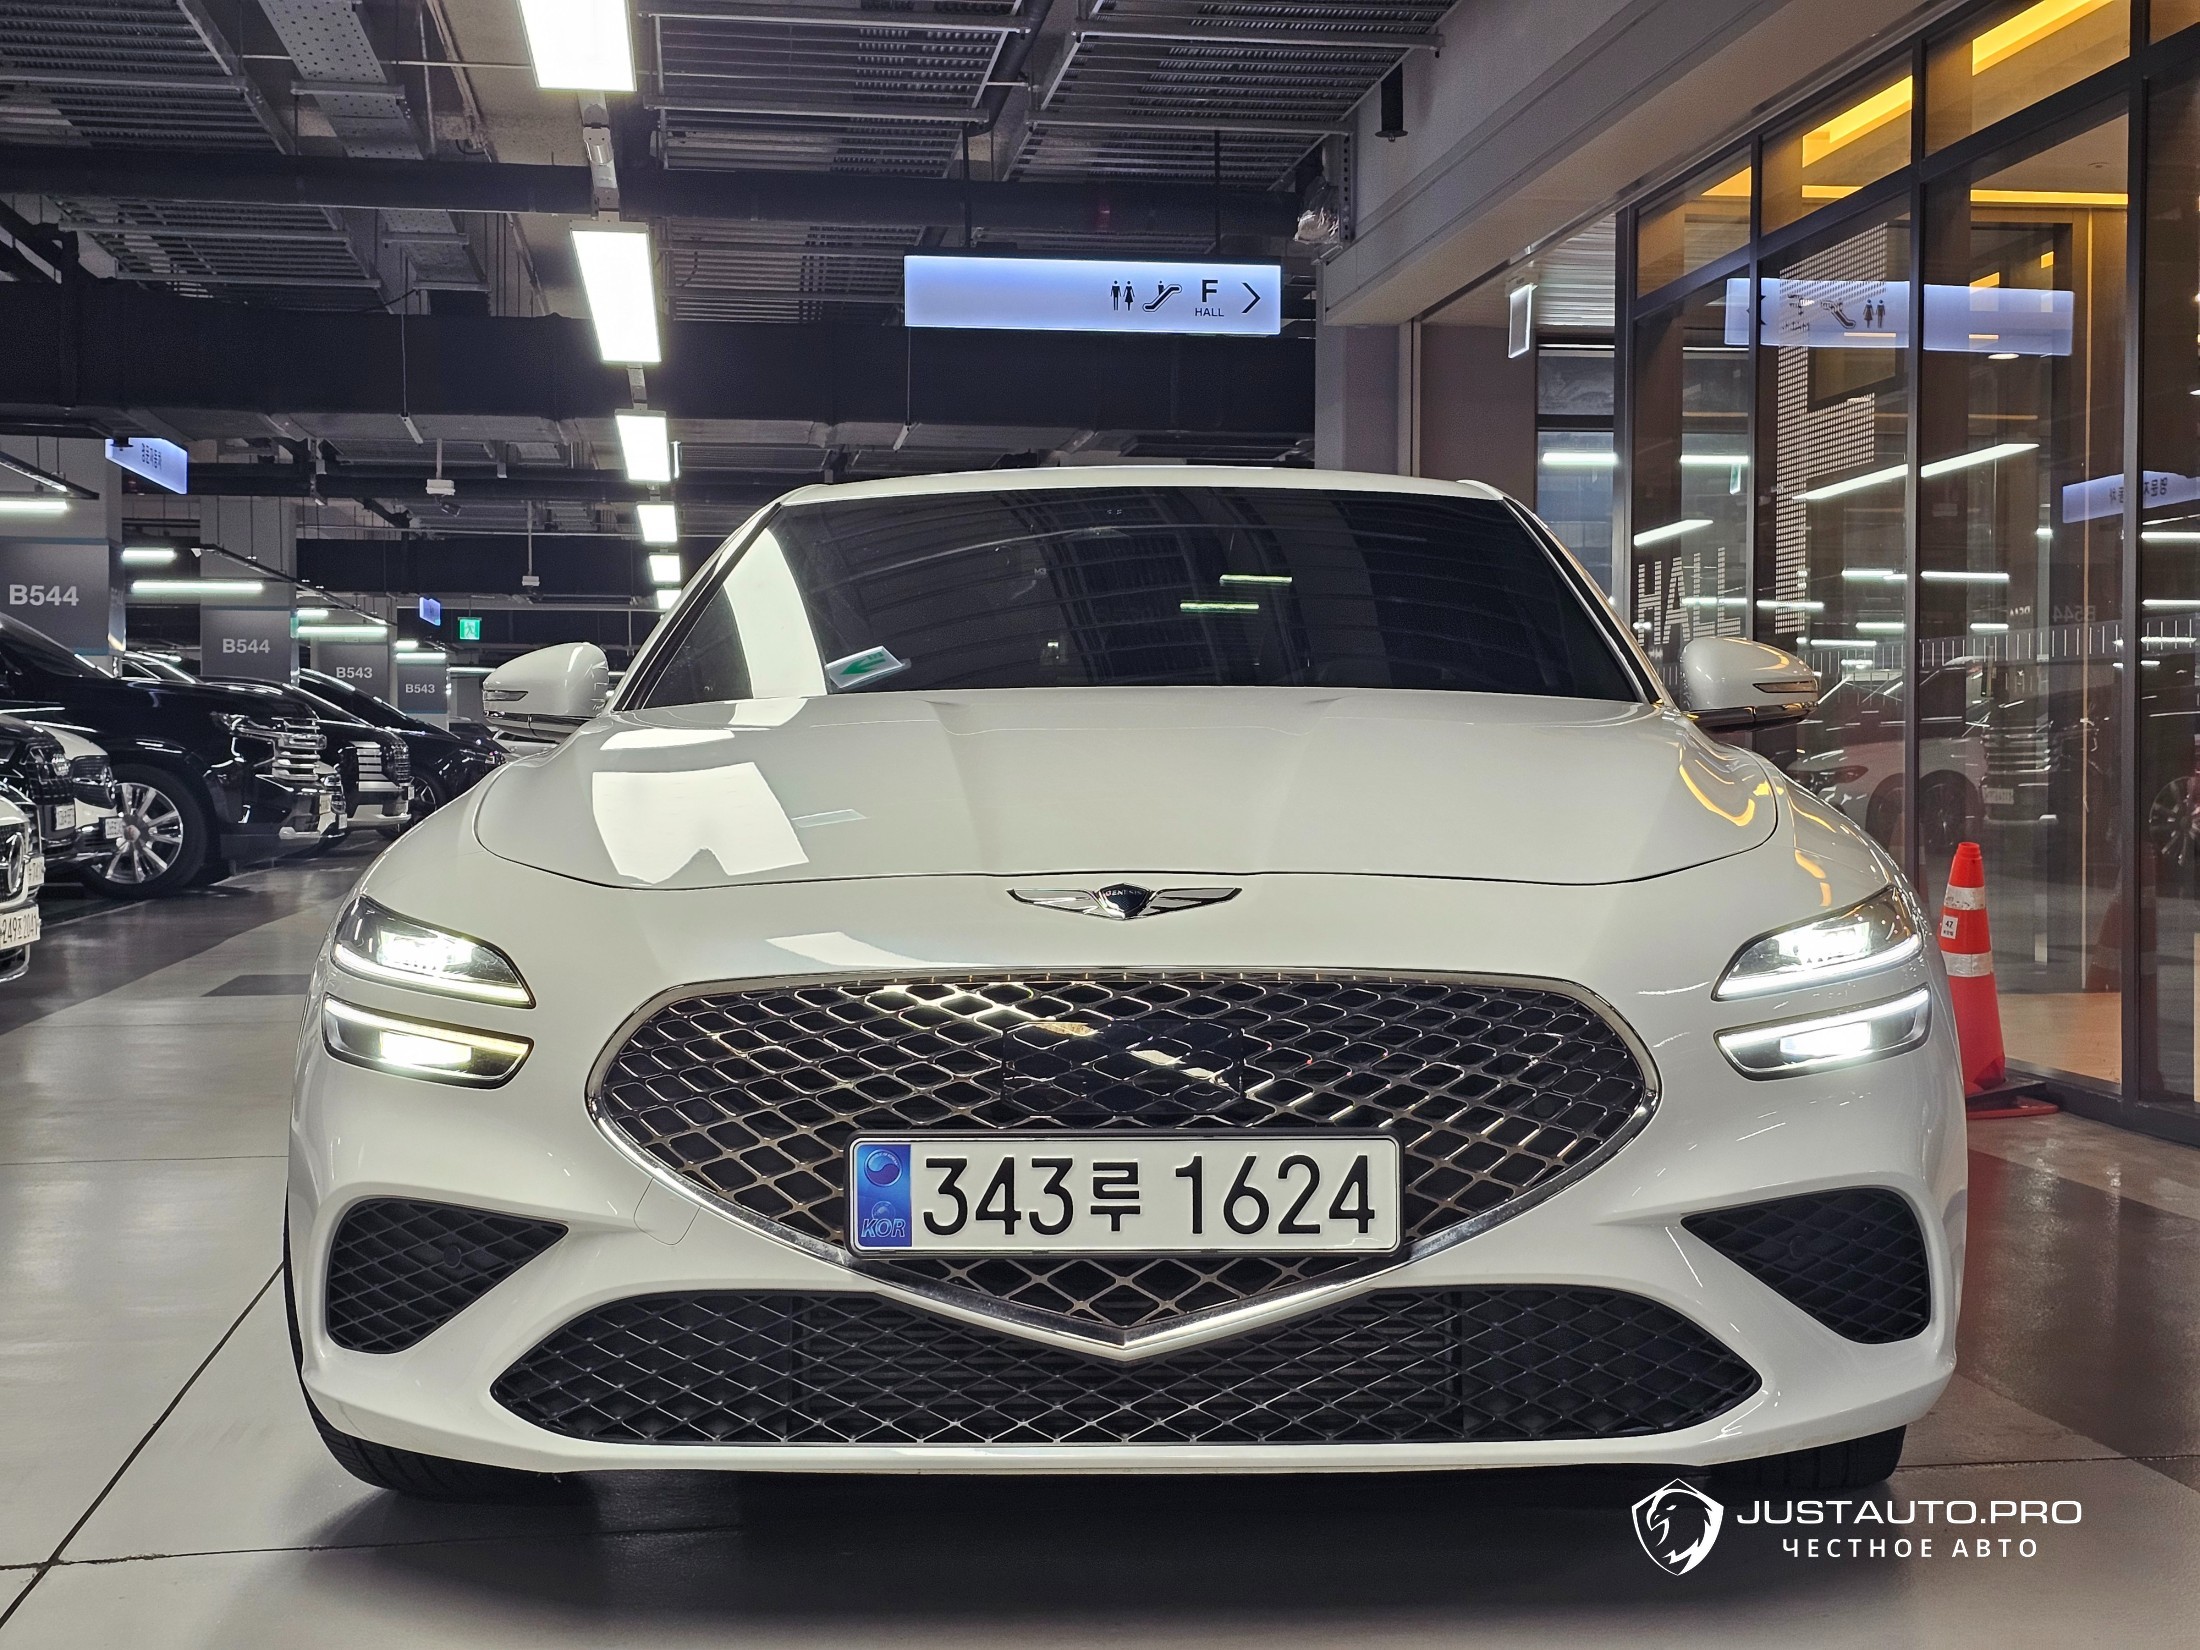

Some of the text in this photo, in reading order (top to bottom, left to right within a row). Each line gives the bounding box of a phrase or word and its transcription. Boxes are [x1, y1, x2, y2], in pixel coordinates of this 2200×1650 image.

[1202, 280, 1218, 302] F
[1195, 308, 1224, 317] HALL
[9, 584, 79, 606] B544
[1638, 547, 1740, 646] HALL
[222, 638, 270, 653] B544
[336, 667, 373, 679] B543
[405, 684, 435, 694] B543
[1175, 1155, 1376, 1236] 1624
[861, 1218, 906, 1238] KOR
